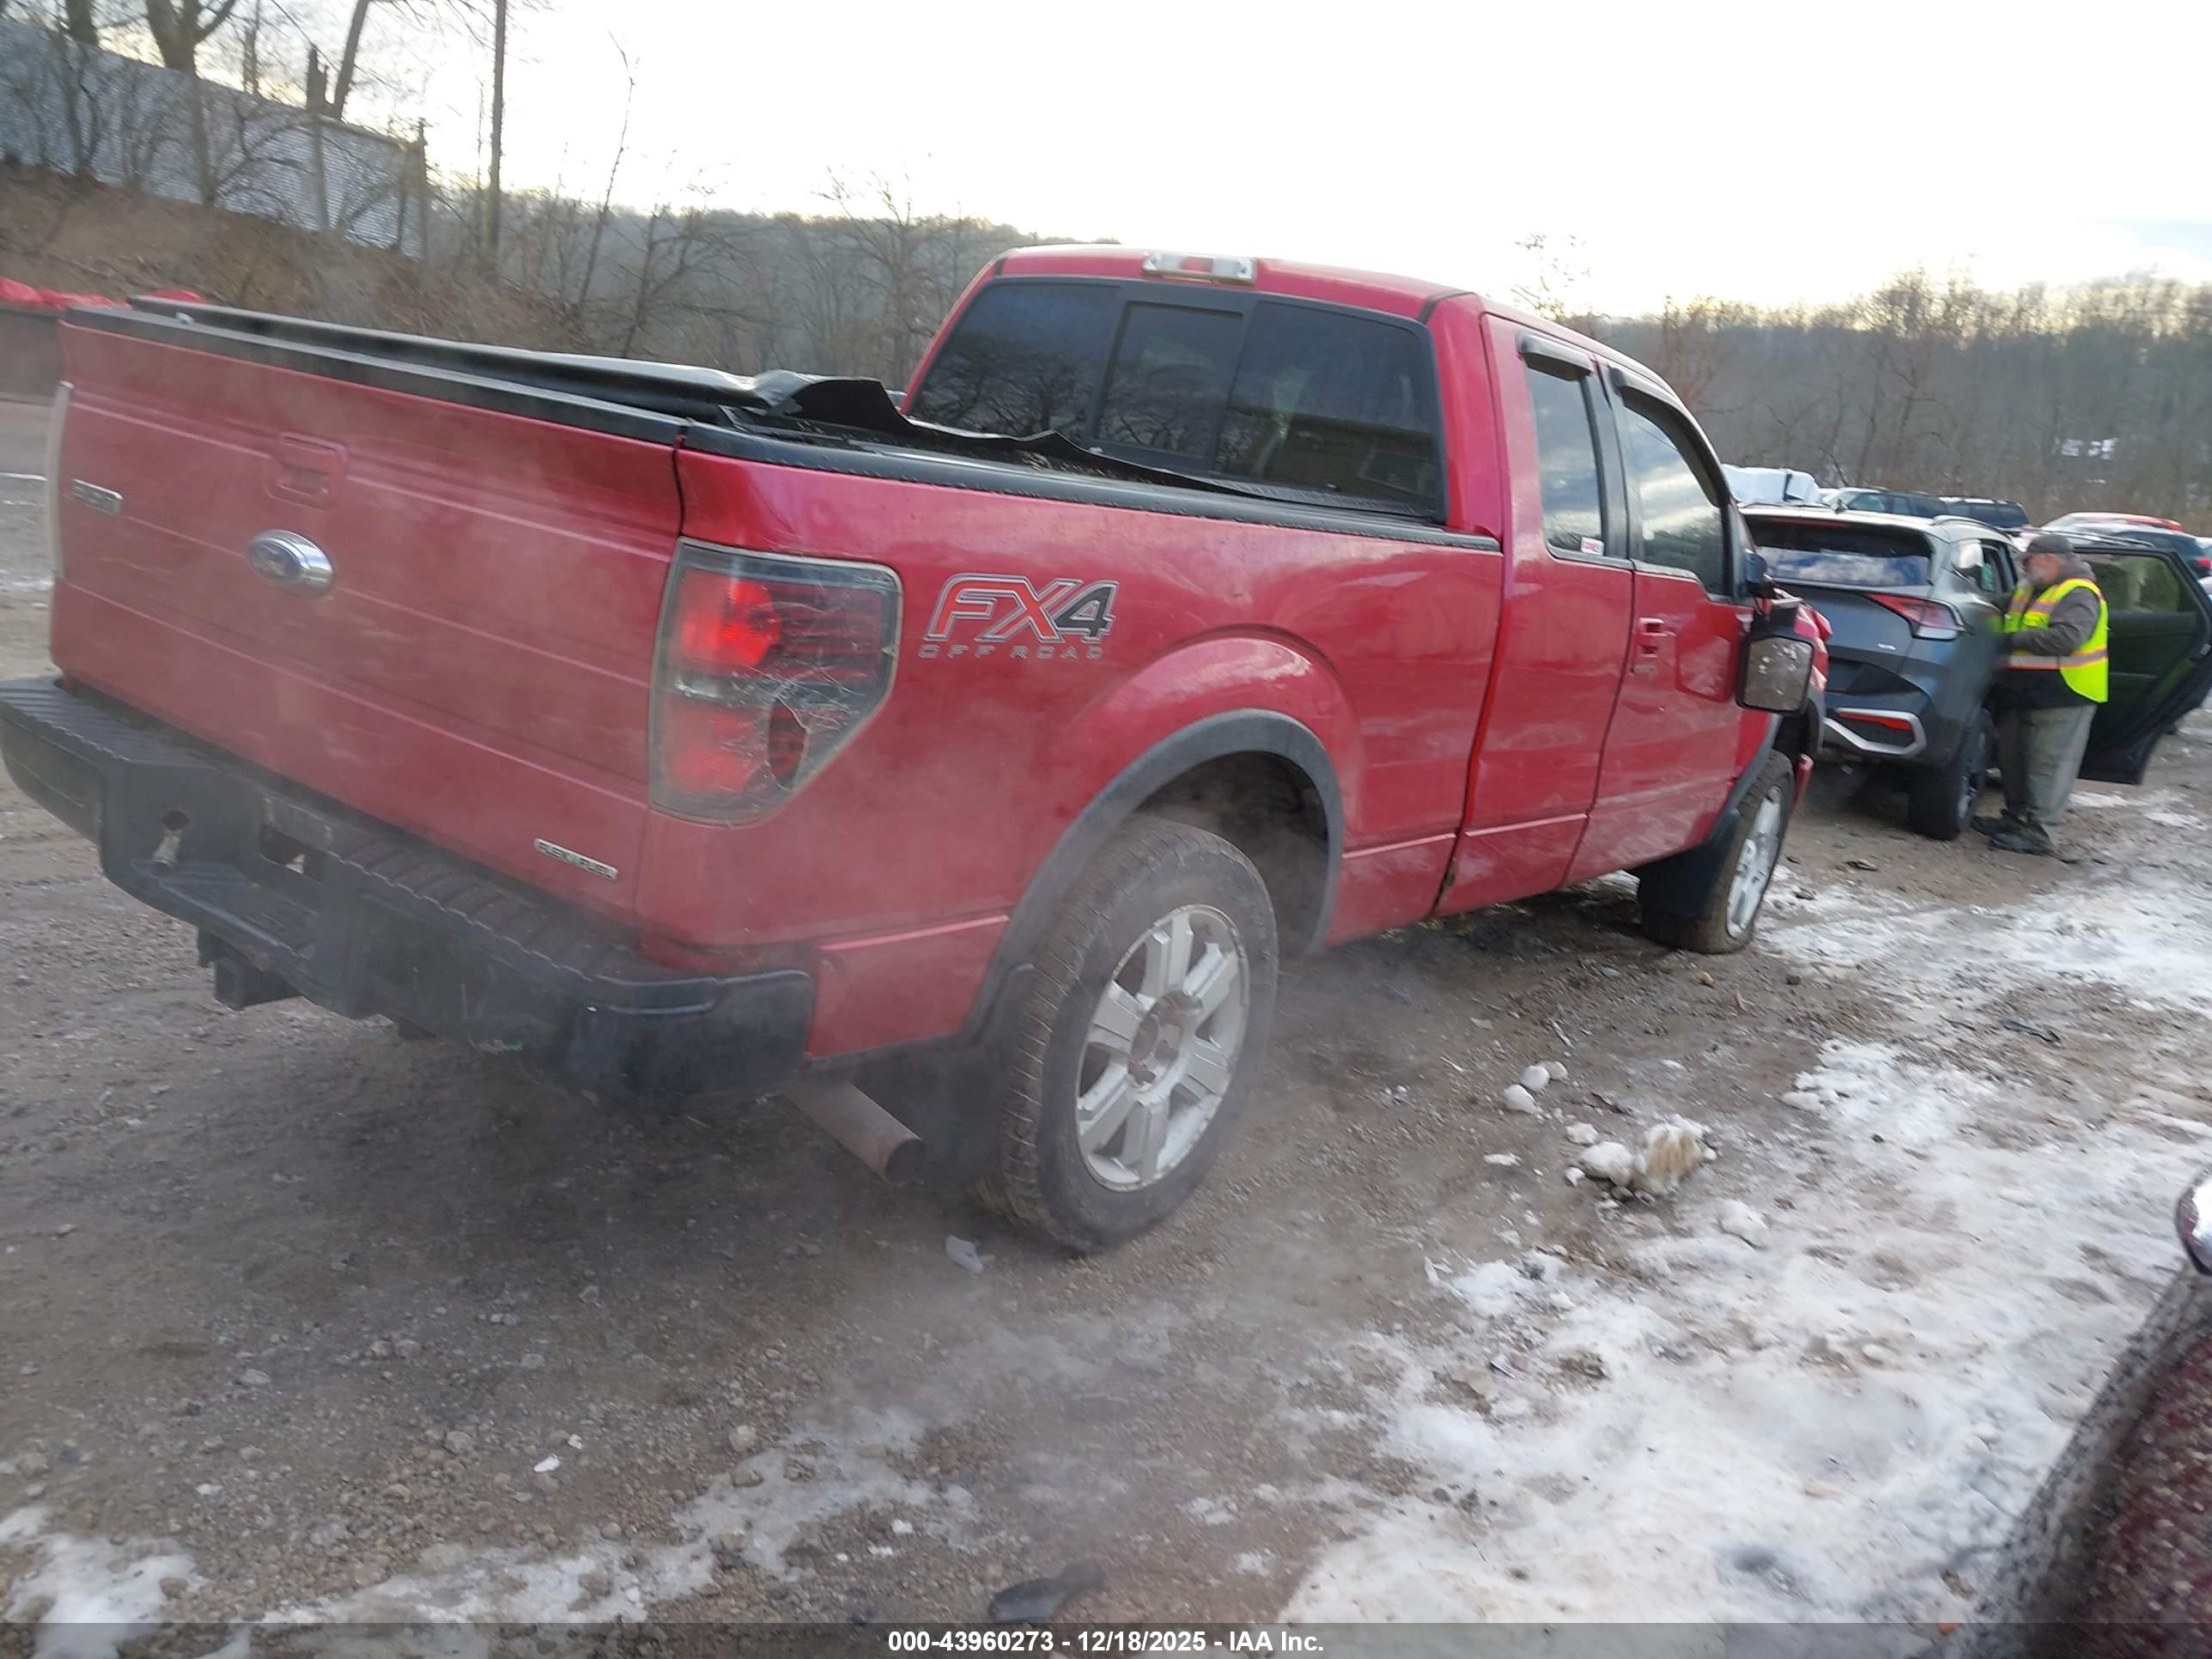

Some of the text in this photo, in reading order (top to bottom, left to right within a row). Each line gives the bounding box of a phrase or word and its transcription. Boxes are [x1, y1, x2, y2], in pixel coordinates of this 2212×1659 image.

[922, 572, 1120, 644] FX4
[917, 644, 1105, 659] OFF ROAD
